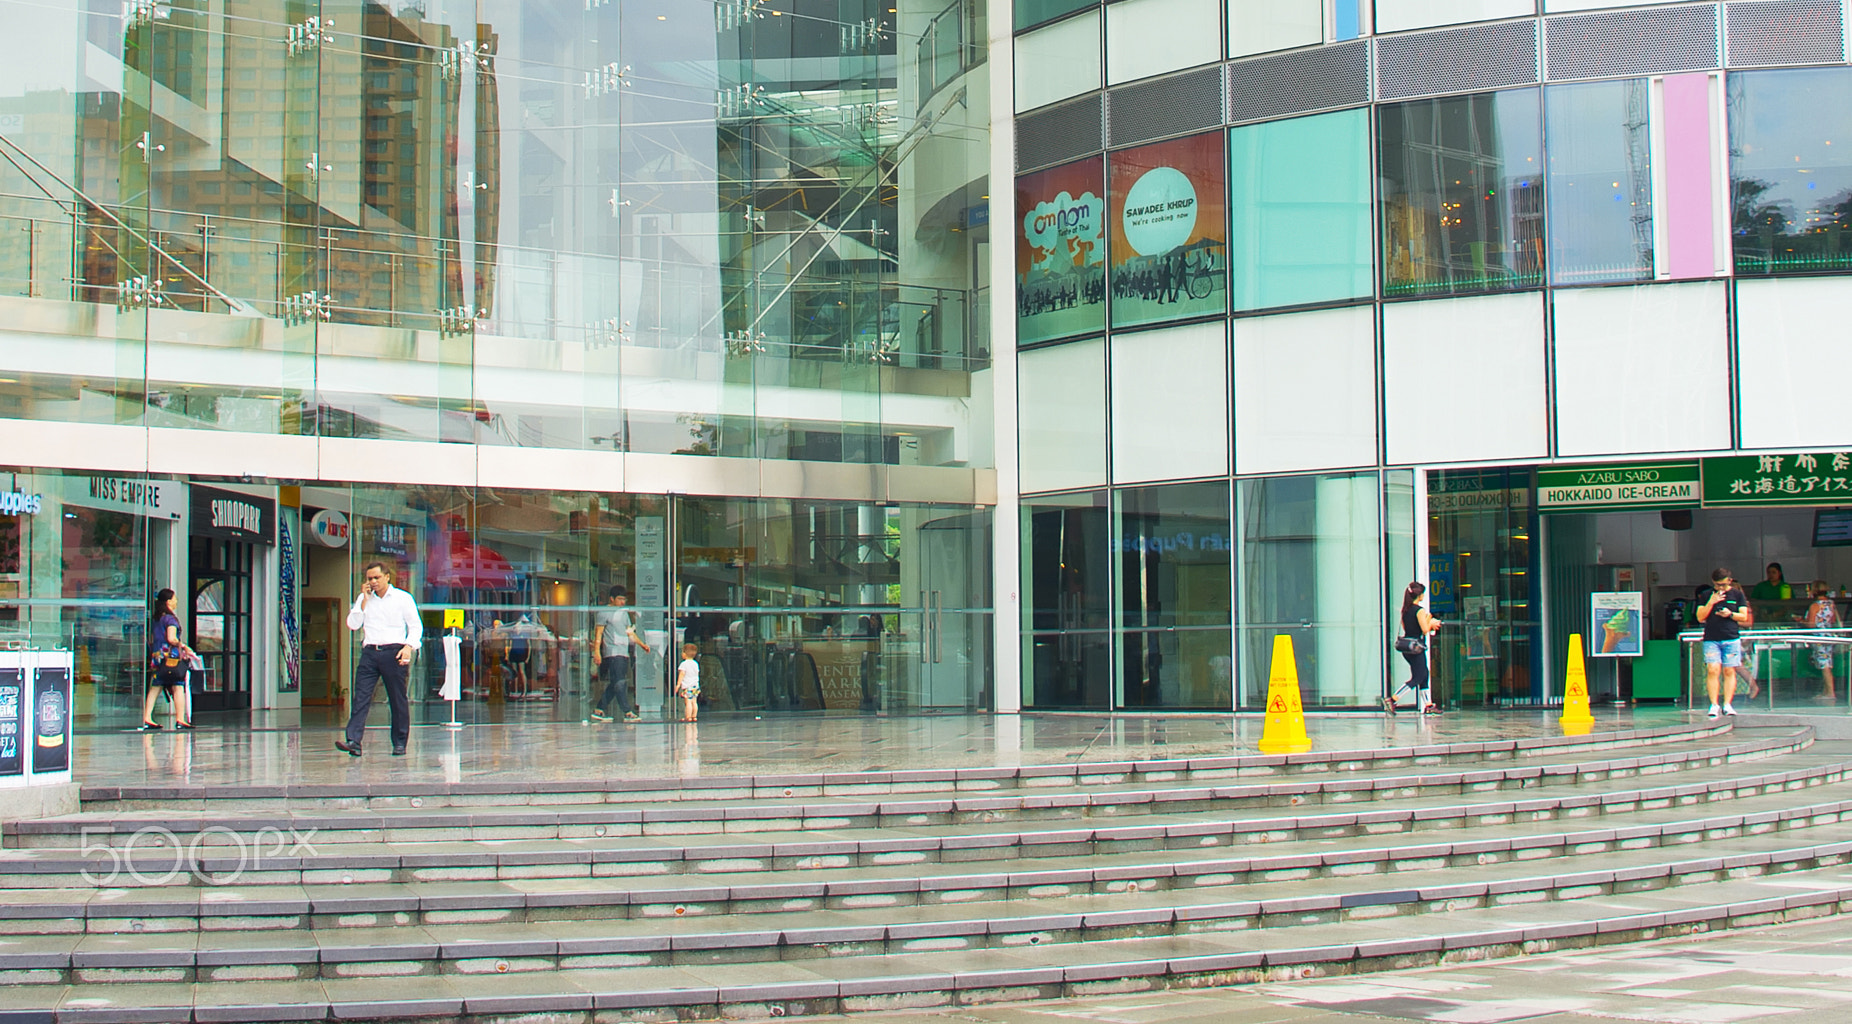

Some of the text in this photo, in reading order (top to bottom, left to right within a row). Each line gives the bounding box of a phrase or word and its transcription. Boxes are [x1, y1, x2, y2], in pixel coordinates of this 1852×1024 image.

[1126, 198, 1194, 218] SAWADEE KHRUP
[1151, 214, 1174, 224] cooking
[1578, 470, 1660, 484] AZABU SABO
[90, 477, 160, 508] MISS EMPIRE
[1548, 485, 1691, 502] HOKKAIDO ICE-CREAM
